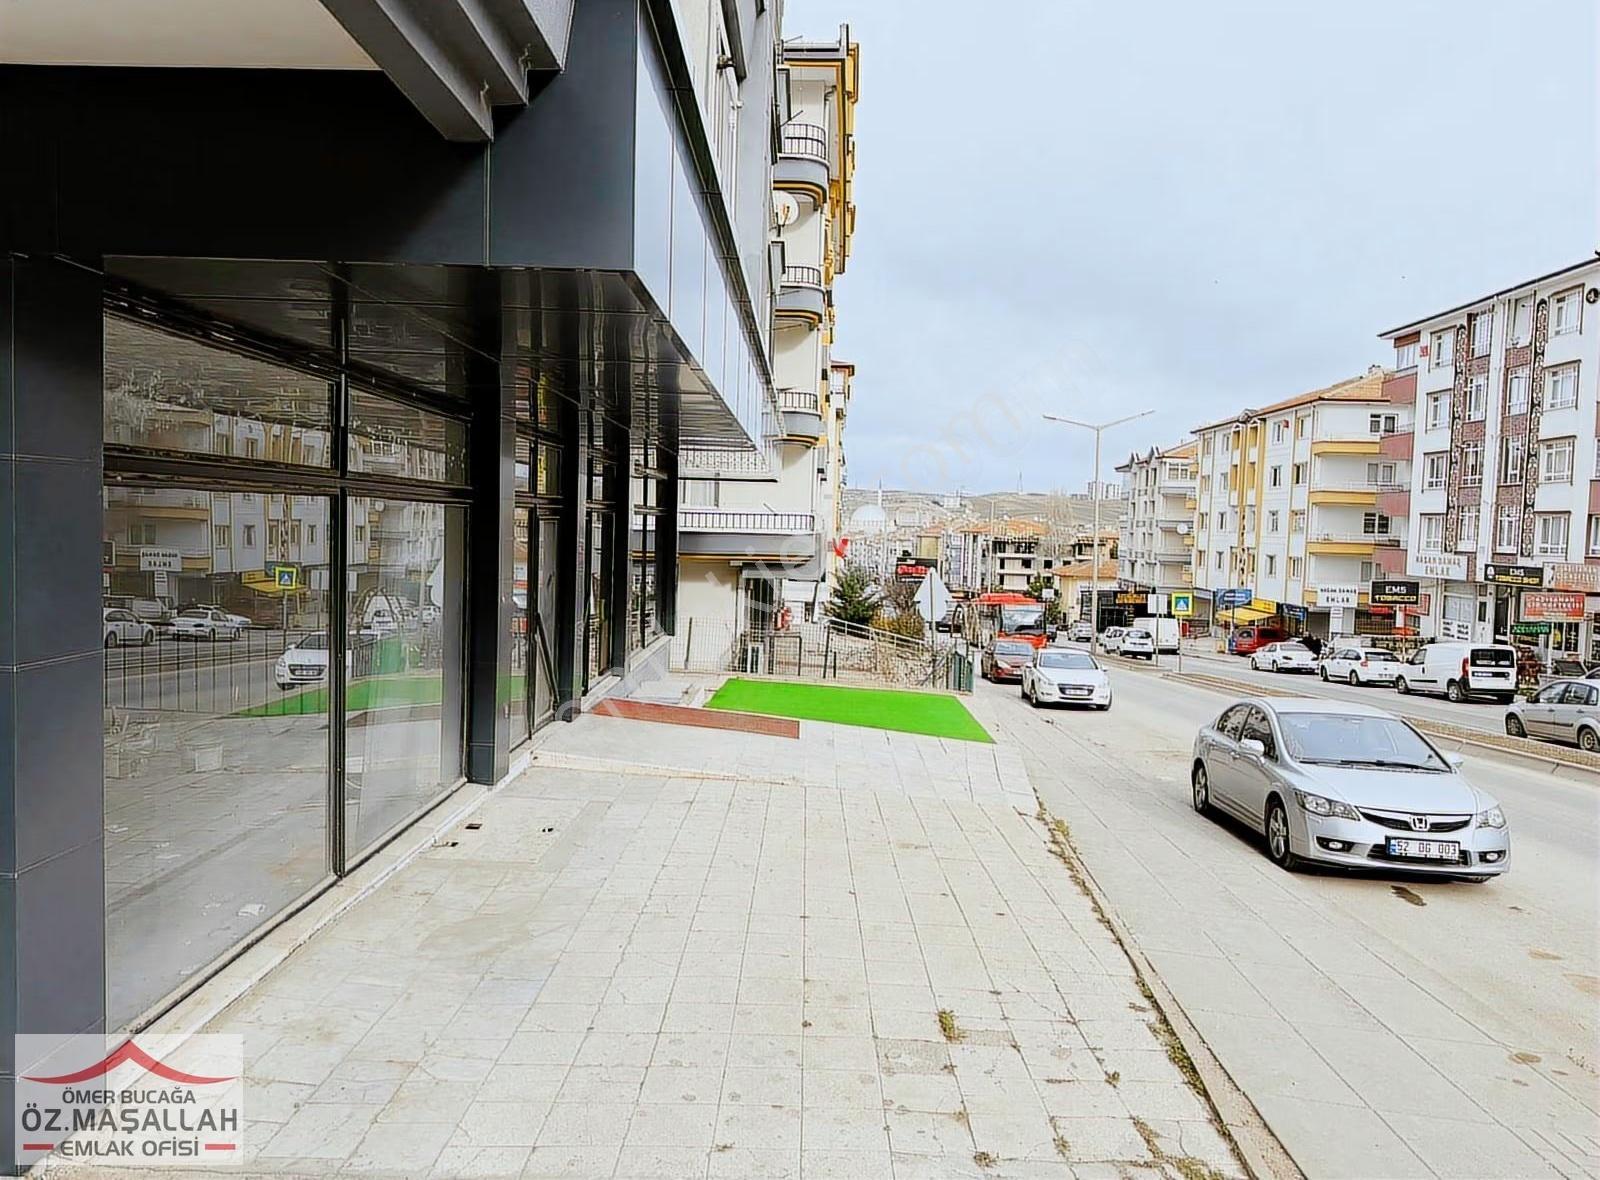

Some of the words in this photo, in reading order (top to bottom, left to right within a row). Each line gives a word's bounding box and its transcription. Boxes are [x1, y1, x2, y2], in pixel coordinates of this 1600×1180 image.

[1385, 585, 1407, 594] EMS
[1374, 594, 1417, 602] TOBACCO
[1397, 841, 1409, 852] 52
[1438, 843, 1457, 854] 003
